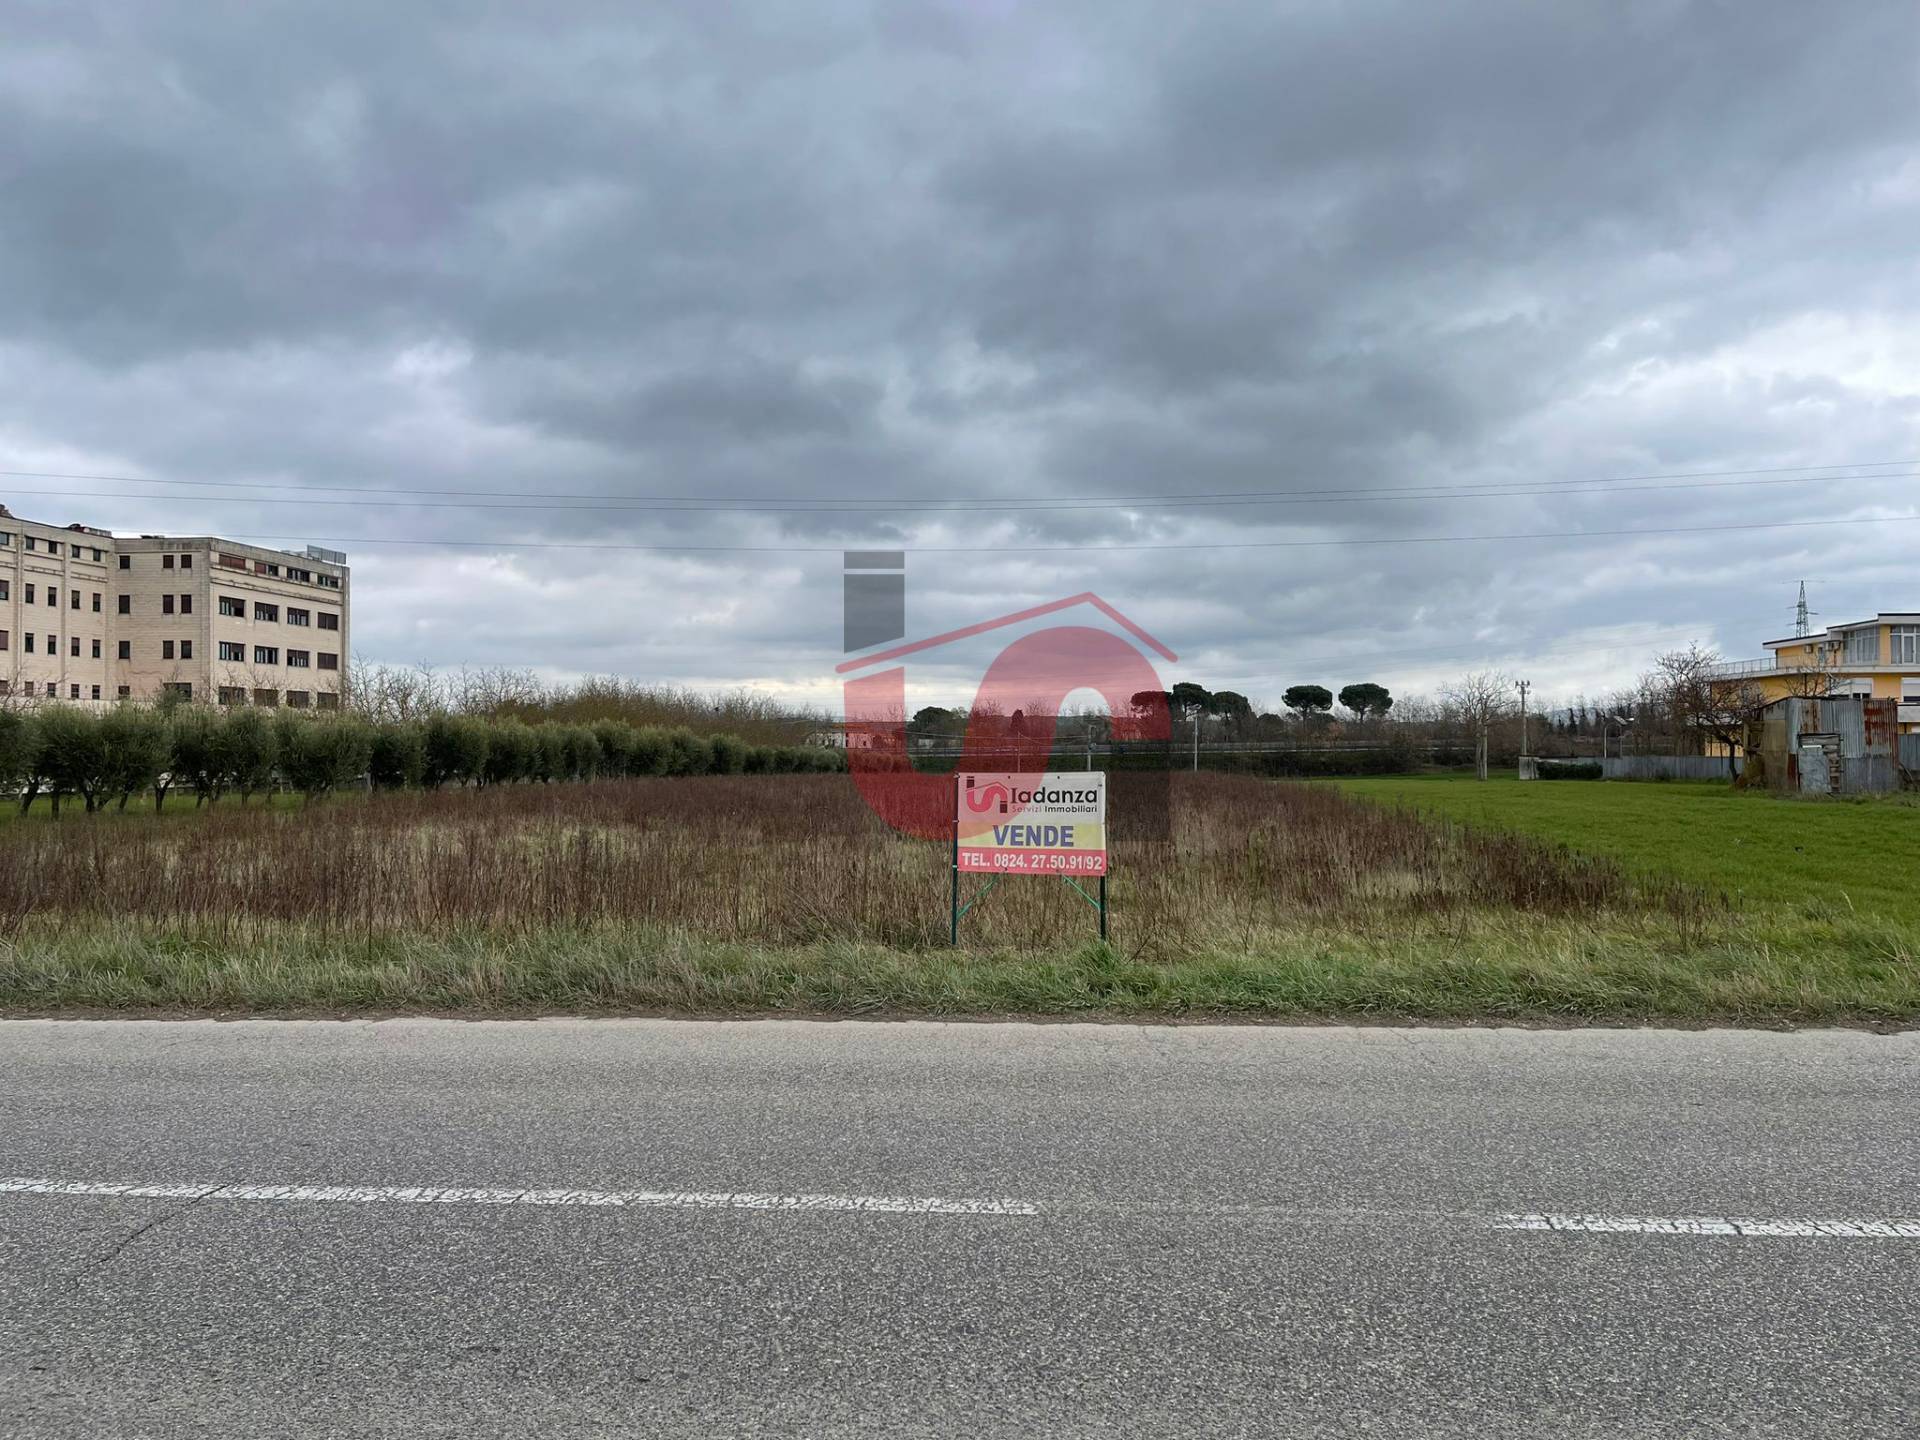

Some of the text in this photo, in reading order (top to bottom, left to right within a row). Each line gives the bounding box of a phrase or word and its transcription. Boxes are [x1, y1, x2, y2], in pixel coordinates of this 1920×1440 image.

[1010, 787, 1097, 804] Iadanza
[1012, 805, 1098, 813] Servizi Immobiliari
[992, 825, 1074, 847] VENDE
[962, 853, 1102, 870] TEL. 0824. 27.50.91/92
